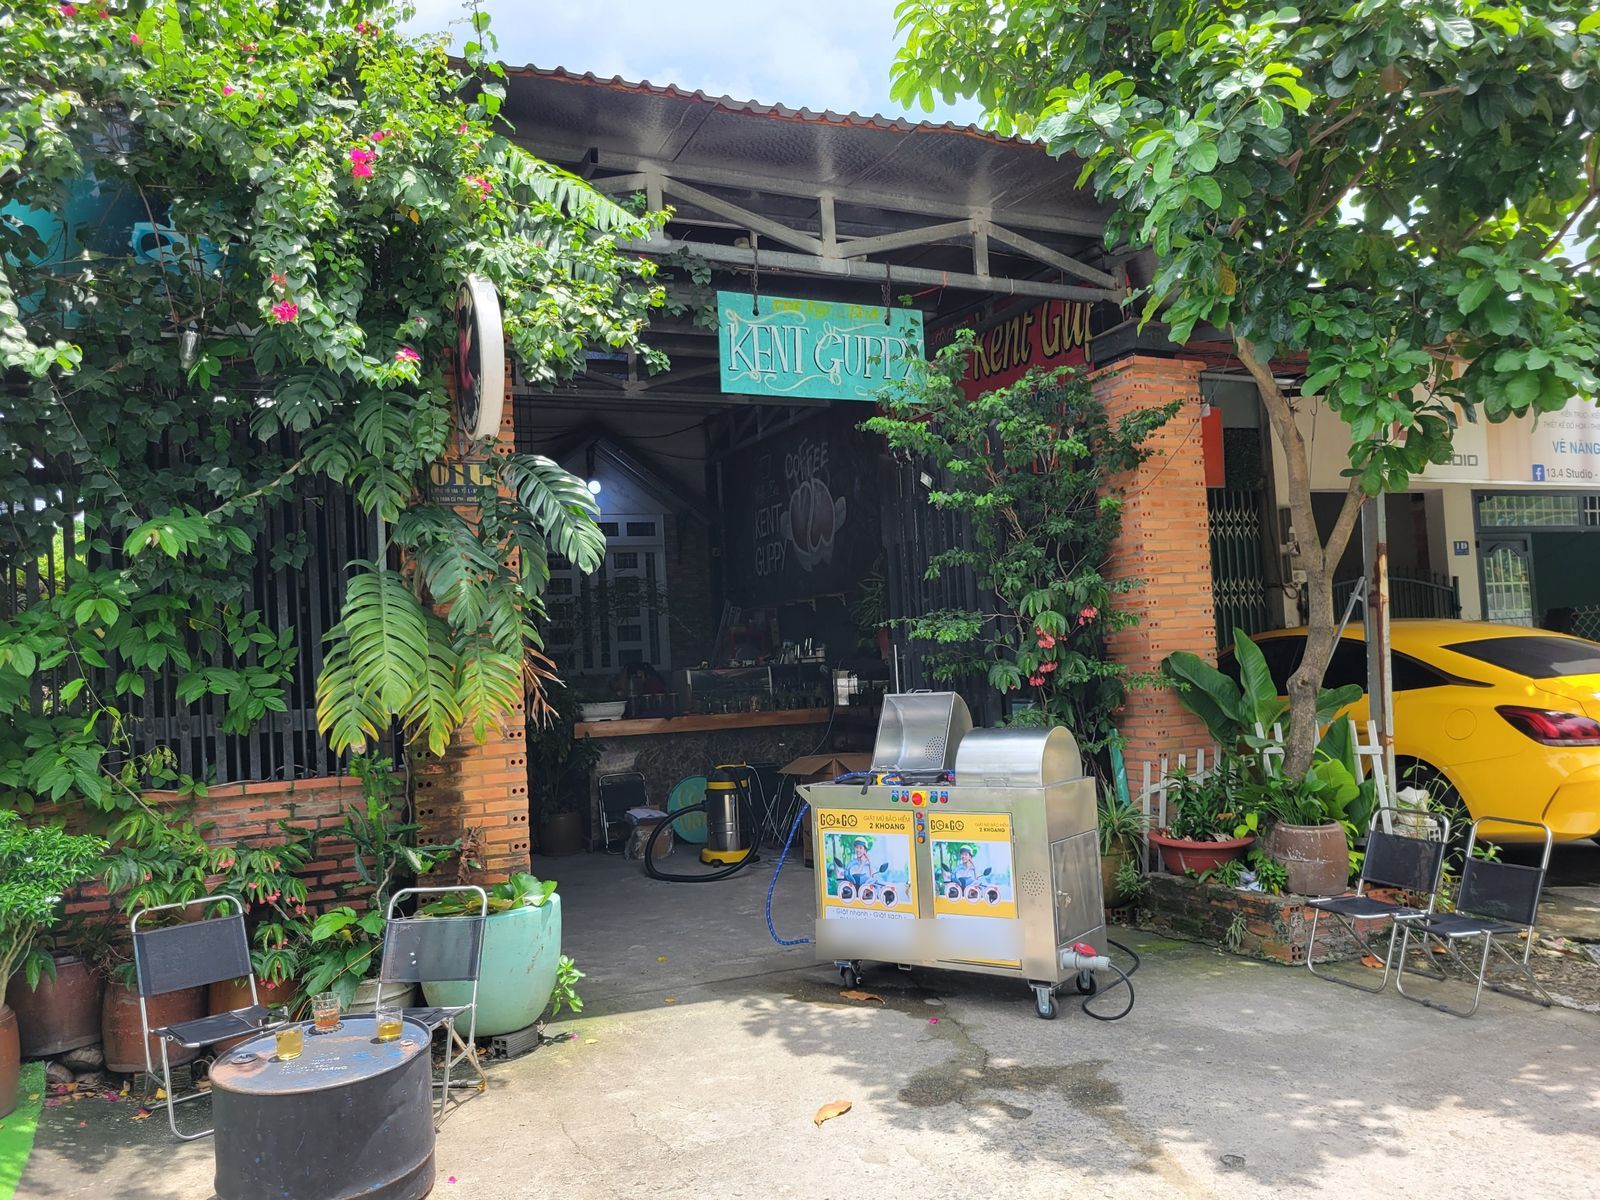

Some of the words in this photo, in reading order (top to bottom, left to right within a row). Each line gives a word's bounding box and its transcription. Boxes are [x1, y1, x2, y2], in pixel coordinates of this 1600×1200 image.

[727, 323, 809, 375] KENT
[813, 333, 924, 382] GUPPY
[973, 311, 1036, 380] Kent
[785, 437, 829, 480] COFFEE
[1444, 454, 1478, 466] DIO
[1546, 468, 1564, 478] 13.4
[1565, 468, 1593, 479] Studio
[754, 503, 783, 540] KENT
[755, 540, 788, 576] GUPPY
[875, 823, 905, 831] KHOANG
